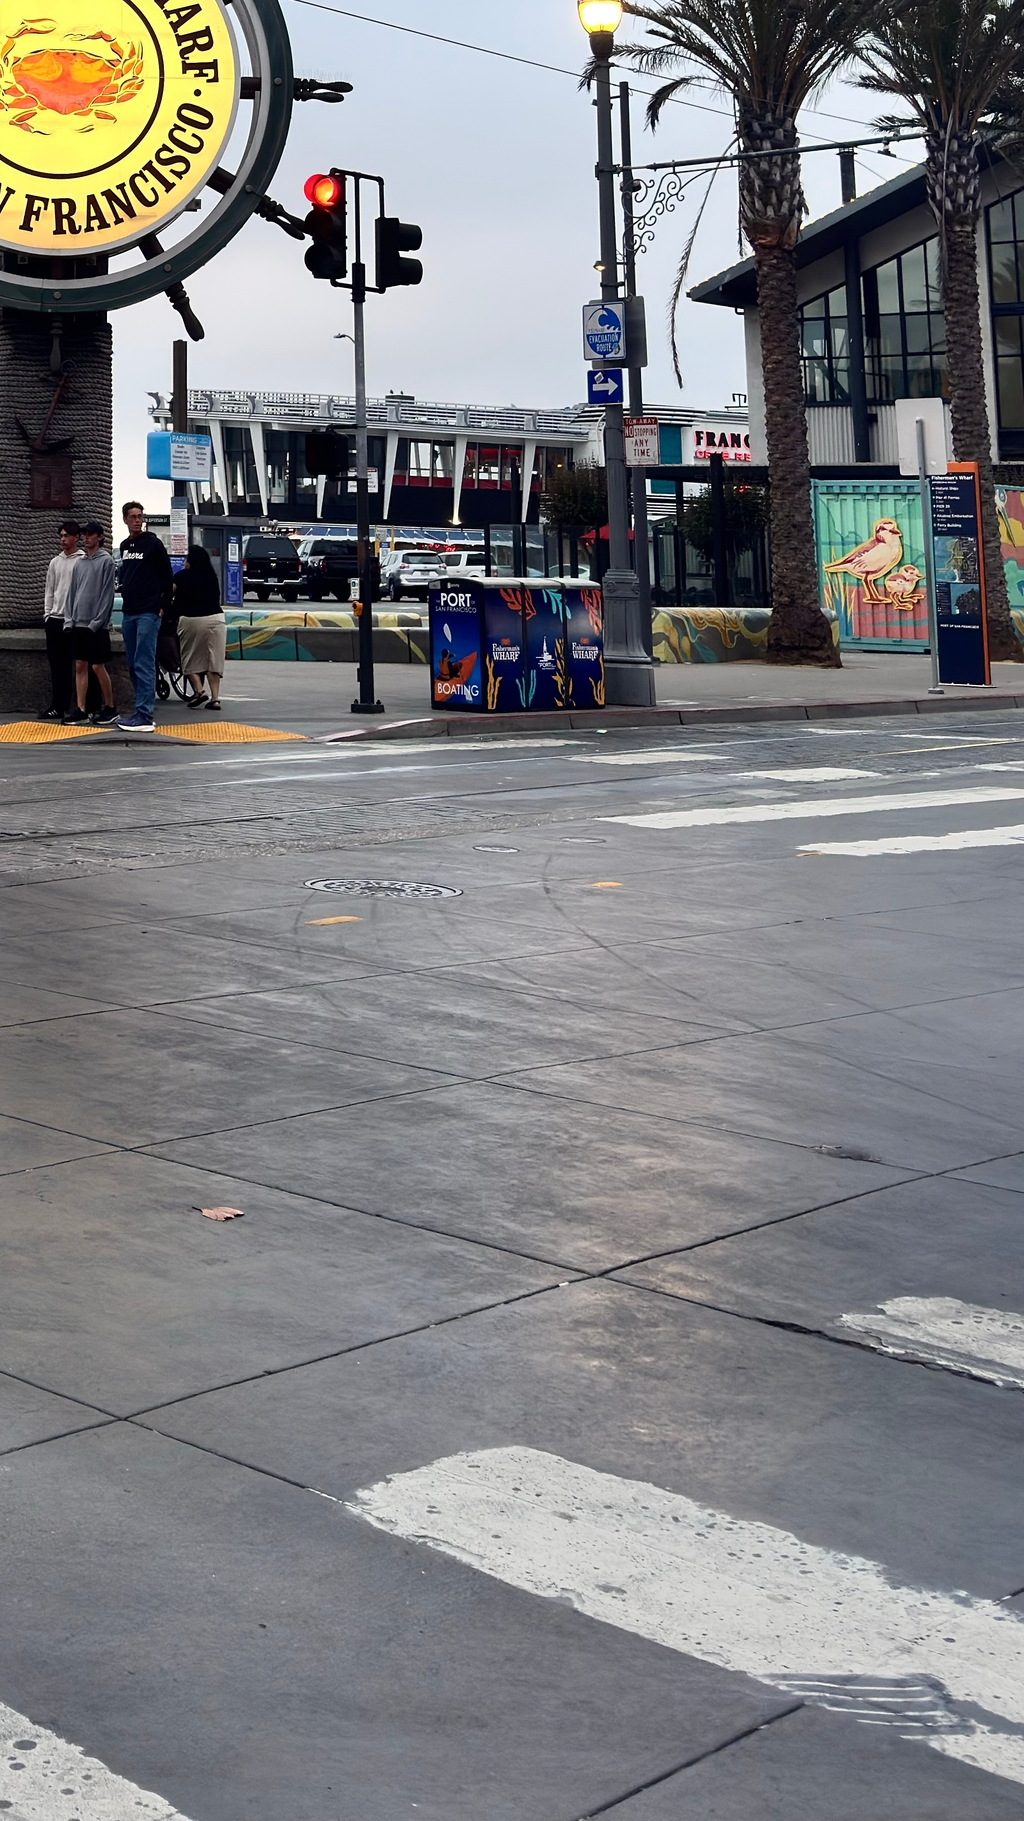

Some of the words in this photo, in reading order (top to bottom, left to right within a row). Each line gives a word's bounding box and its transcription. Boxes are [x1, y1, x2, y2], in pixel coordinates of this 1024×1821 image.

[19, 102, 214, 235] FRANCISCO
[589, 334, 619, 344] EVACUATION
[596, 343, 612, 352] ROUTE
[634, 427, 657, 437] STOPPING
[172, 435, 197, 444] PARKING
[634, 438, 649, 447] ANY
[633, 448, 651, 457] TIME
[440, 592, 472, 607] PORT
[446, 606, 477, 614] FRANCISCO
[492, 643, 521, 652] Fisherman's
[571, 642, 599, 652] Fisherman's
[492, 651, 521, 663] WHARF
[572, 650, 599, 661] WHARF
[437, 682, 480, 697] BOATING
